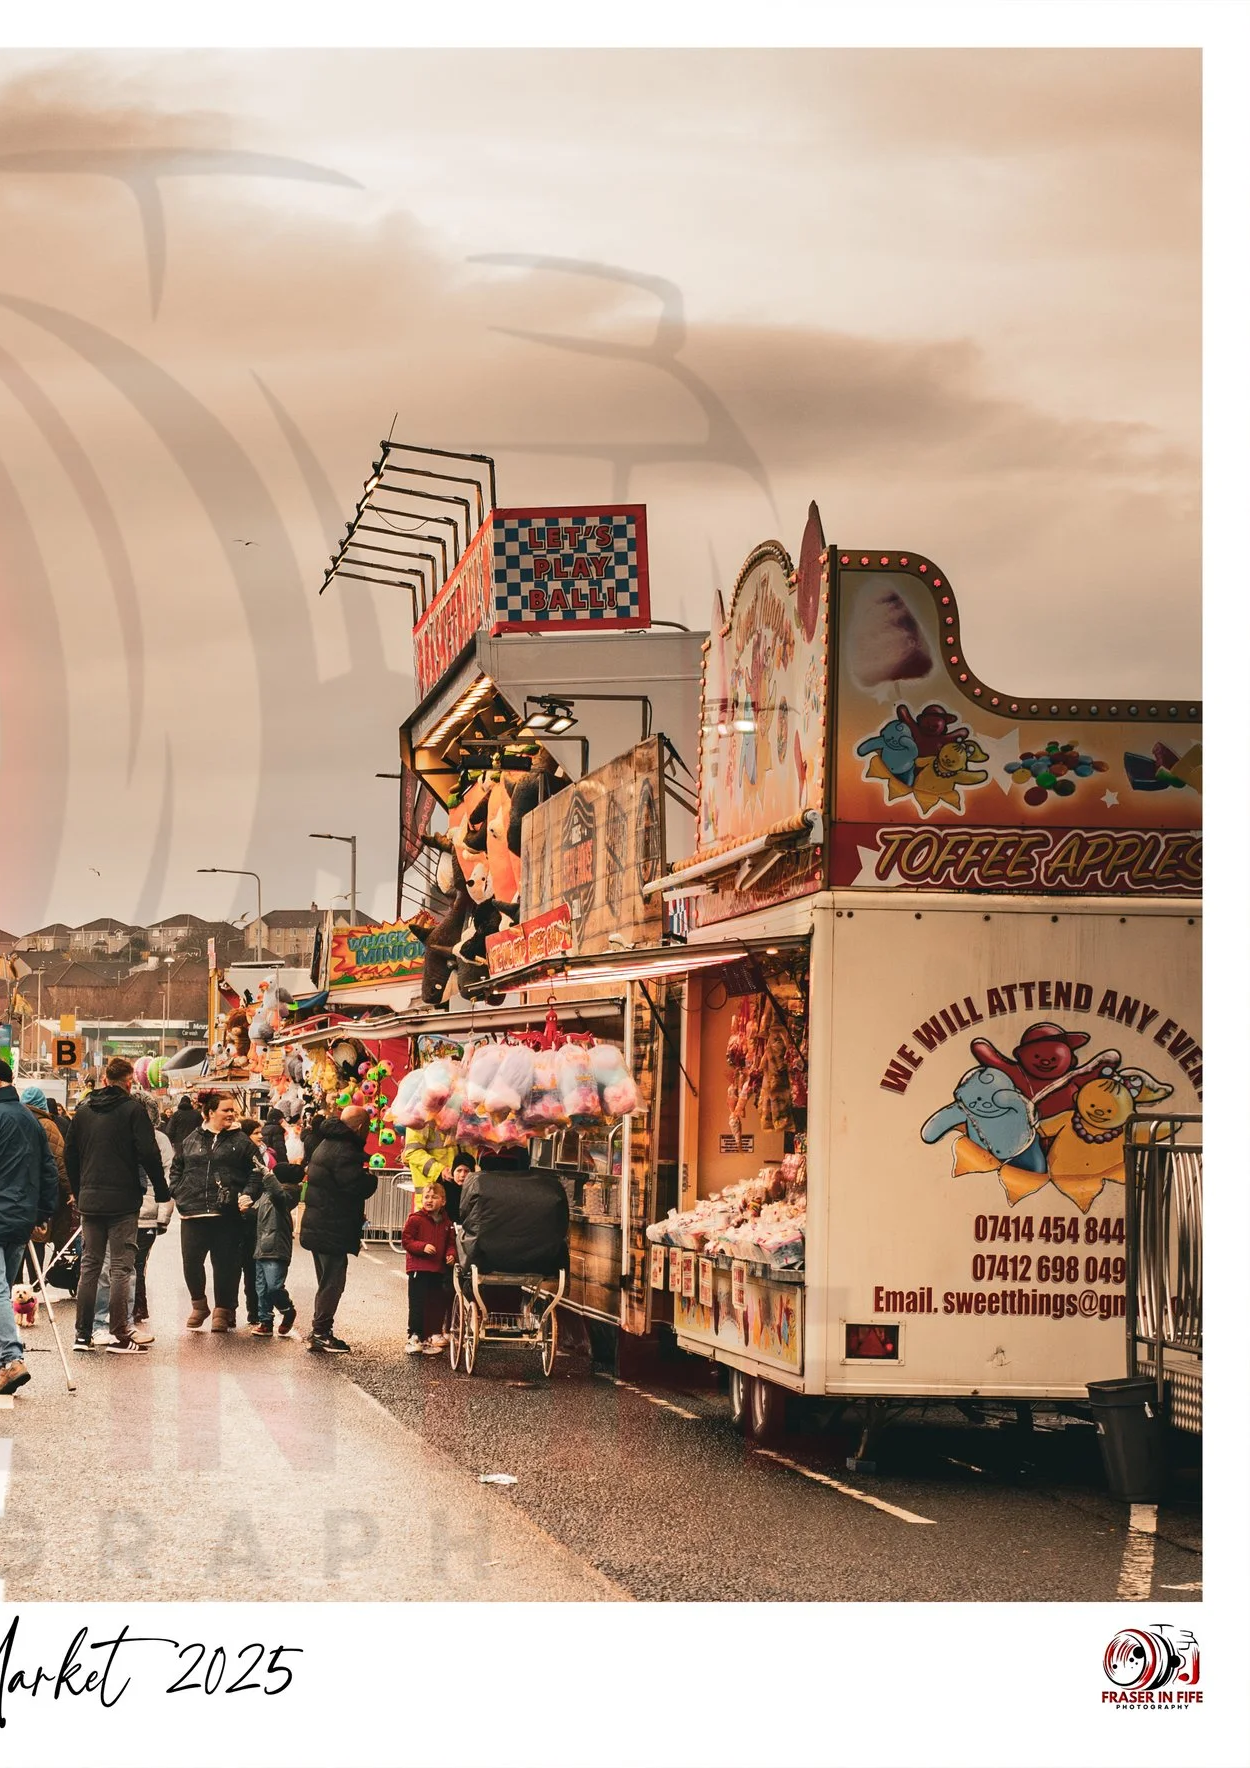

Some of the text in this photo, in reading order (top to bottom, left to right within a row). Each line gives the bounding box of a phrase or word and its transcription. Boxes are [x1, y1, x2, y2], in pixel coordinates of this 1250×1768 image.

[527, 523, 614, 550] LET'S
[533, 553, 613, 581] PLAY
[528, 586, 619, 612] BALL!
[877, 832, 1047, 880] TOFFEE
[348, 929, 411, 951] WHACK
[56, 1040, 77, 1066] B
[879, 980, 1203, 1103] WE WILL ATTEND ANY EVEN
[974, 1214, 1126, 1244] 07414 454 844
[972, 1253, 1126, 1285] 07412 698 049
[874, 1286, 1126, 1320] Email. sweetthings@gm
